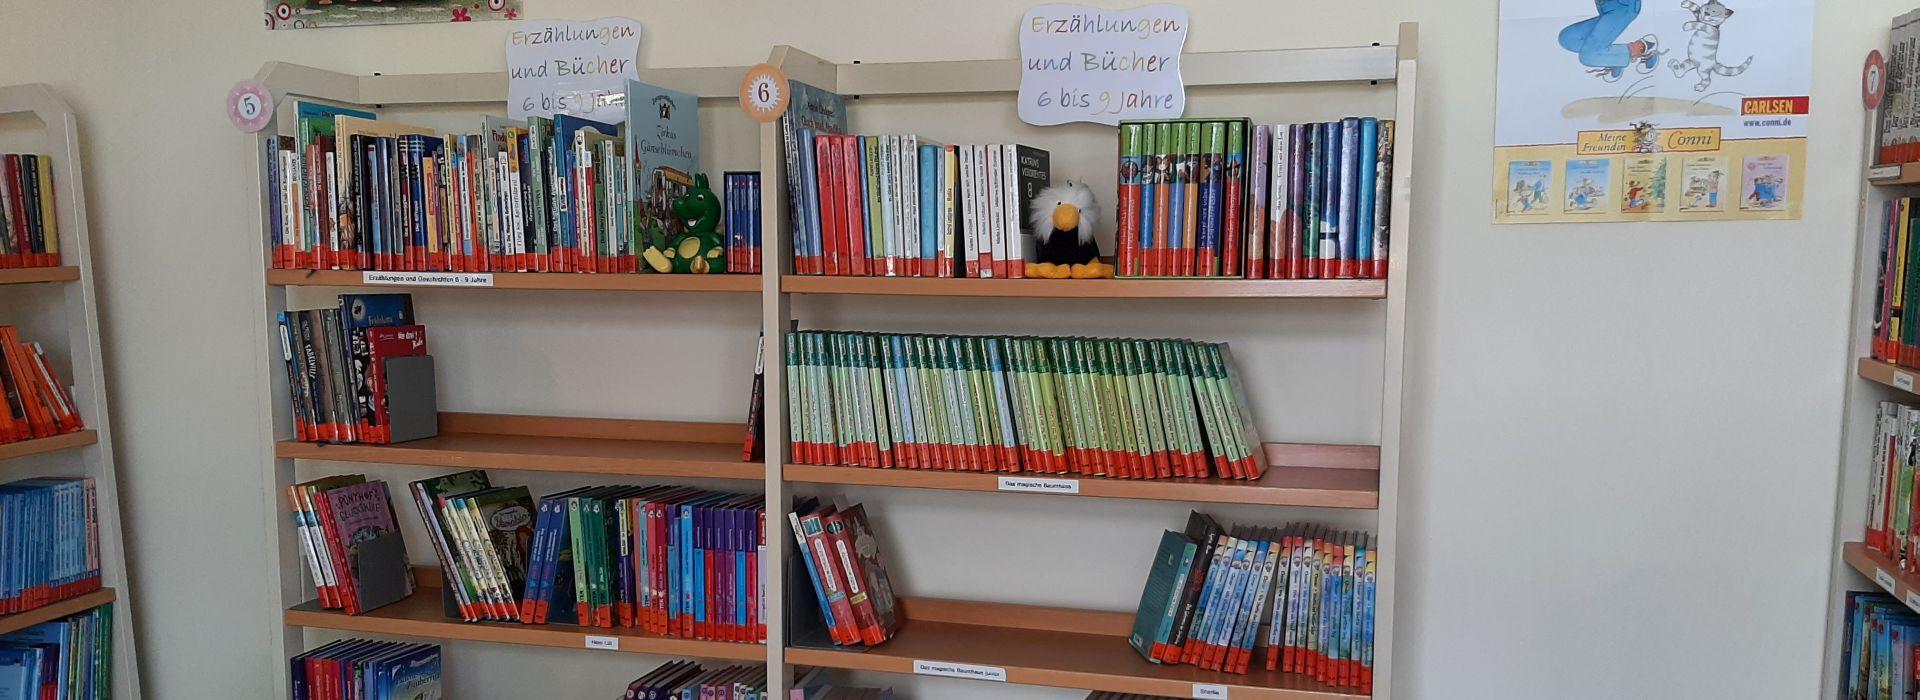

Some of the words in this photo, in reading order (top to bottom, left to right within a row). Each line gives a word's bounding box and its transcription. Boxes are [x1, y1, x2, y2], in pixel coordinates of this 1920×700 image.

[512, 24, 634, 45] Erzählungen
[1032, 14, 1180, 40] Erzählungen
[511, 60, 548, 79] und
[554, 56, 630, 77] Bücher
[1028, 52, 1072, 71] und
[1081, 51, 1170, 72] Bücher
[1870, 70, 1877, 91] 7
[522, 96, 535, 111] 6
[541, 93, 568, 111] bis
[758, 82, 770, 102] 6
[1037, 91, 1051, 107] 6
[1060, 88, 1090, 107] bis
[1090, 91, 1112, 115] 9
[1108, 90, 1173, 114] Jahre
[244, 96, 255, 115] 5
[1743, 99, 1793, 114] CARLSEN
[1743, 118, 1792, 127] www.conni.de
[1583, 142, 1627, 152] Freundin
[1597, 133, 1627, 143] Meine
[1667, 129, 1713, 149] Conni
